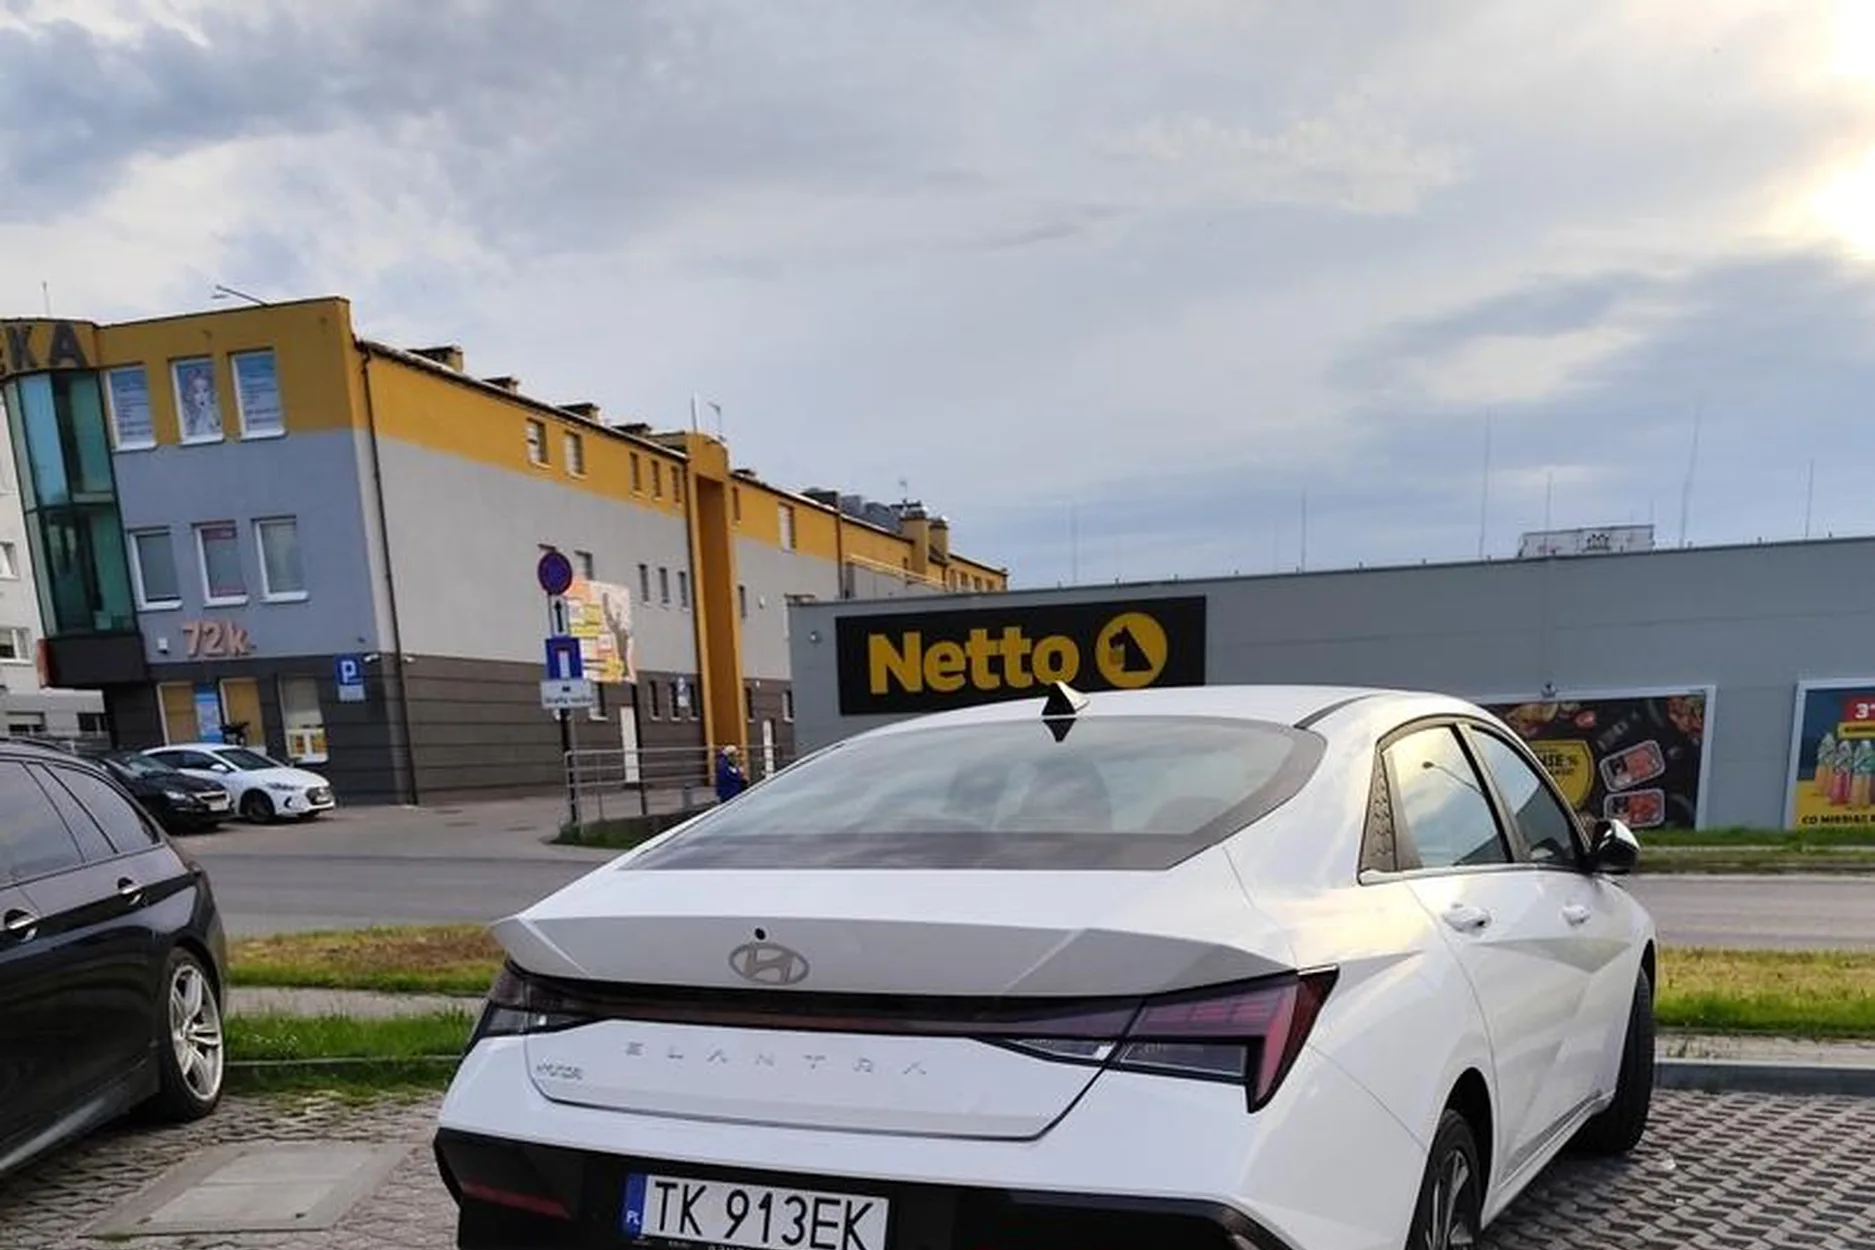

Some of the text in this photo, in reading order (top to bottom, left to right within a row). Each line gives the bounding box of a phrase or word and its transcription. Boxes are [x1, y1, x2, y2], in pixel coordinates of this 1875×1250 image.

[0, 325, 90, 370] KA
[341, 660, 357, 683] P
[868, 626, 1079, 694] Netto
[626, 1041, 927, 1075] ELANTRA
[654, 1177, 707, 1237] TK
